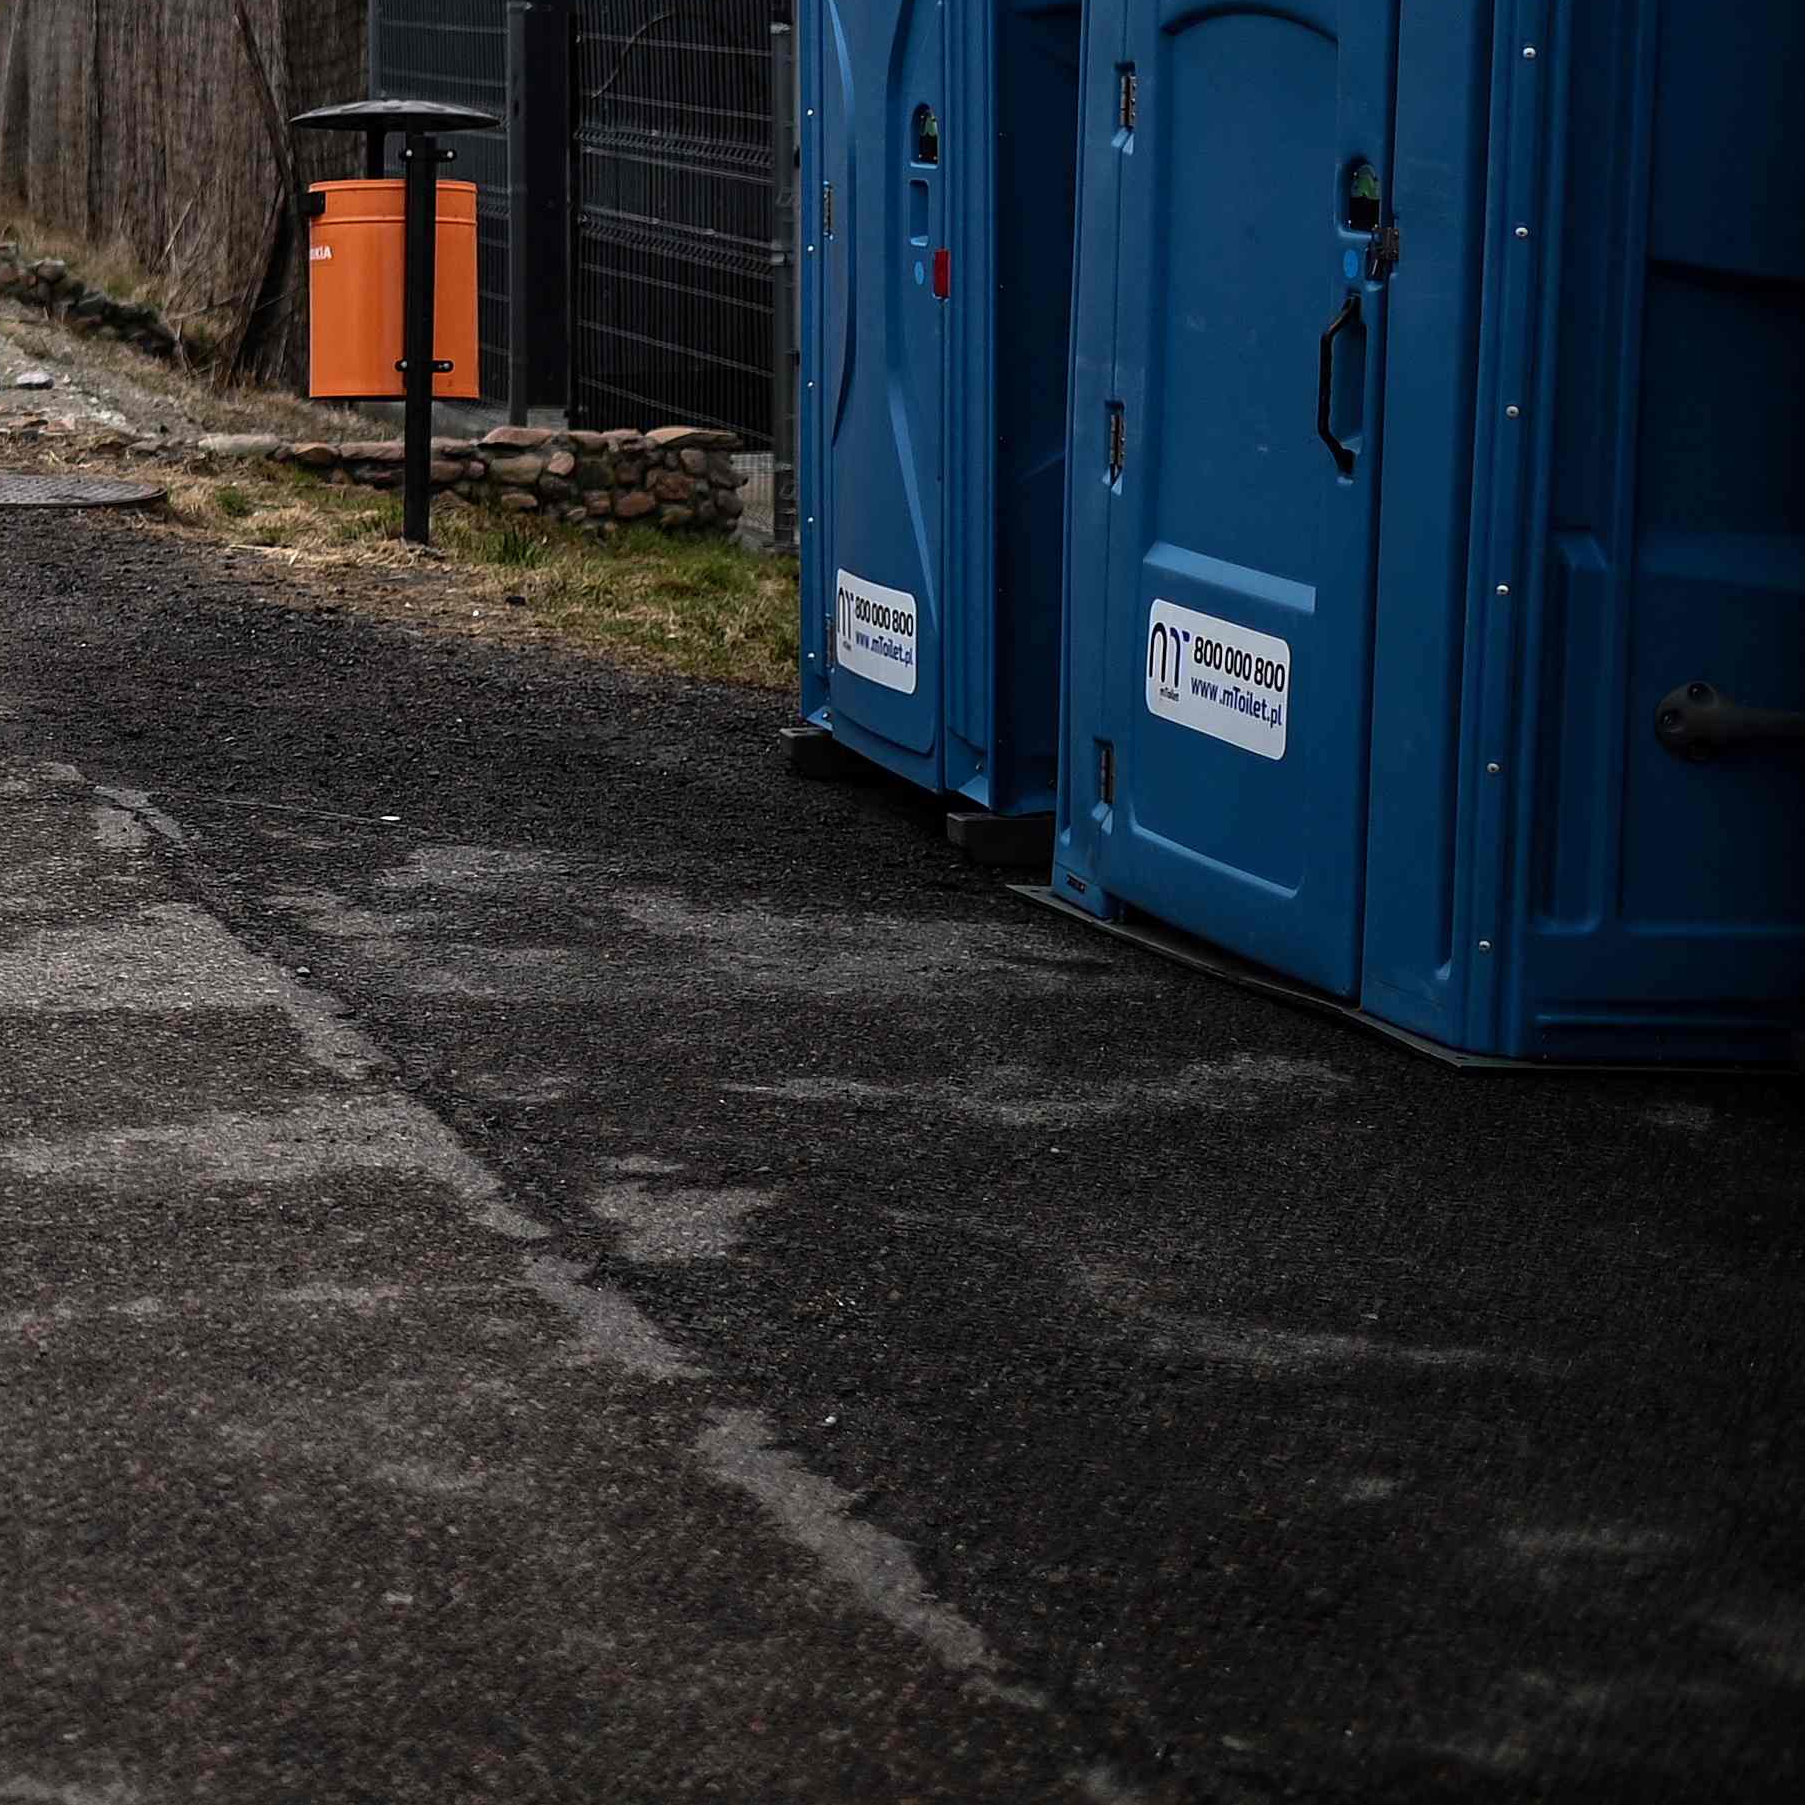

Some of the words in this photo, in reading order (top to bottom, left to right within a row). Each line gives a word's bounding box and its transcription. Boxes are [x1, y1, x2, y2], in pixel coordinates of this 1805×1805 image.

[855, 596, 871, 623] 800
[871, 603, 891, 630] 000
[892, 609, 914, 637] 800
[1194, 636, 1223, 670] 800
[1224, 647, 1252, 681] 000
[1254, 657, 1285, 693] 800
